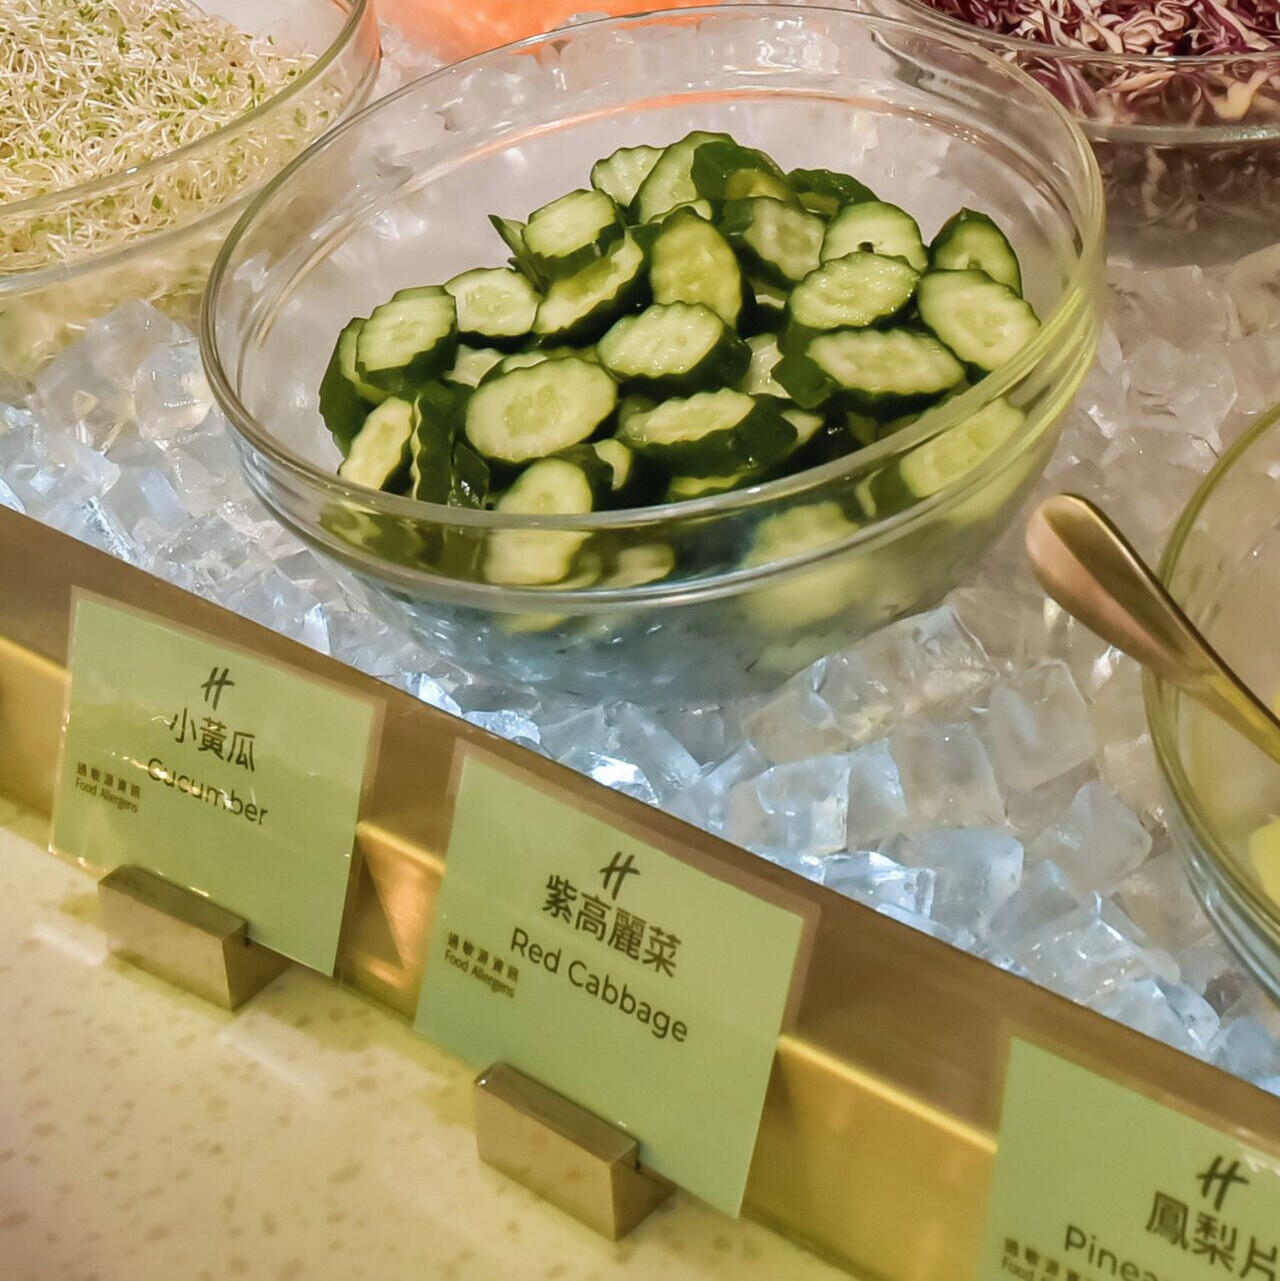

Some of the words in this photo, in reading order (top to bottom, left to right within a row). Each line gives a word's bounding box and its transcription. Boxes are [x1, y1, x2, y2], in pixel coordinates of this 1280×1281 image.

[169, 707, 256, 774] 小黃瓜
[75, 777, 98, 797] Food
[147, 757, 269, 826] Cucumber
[444, 947, 469, 973] Food
[541, 874, 682, 979] 紫高麗菜
[510, 926, 563, 975] Red
[567, 959, 689, 1043] Cabbage
[1145, 1190, 1278, 1281] 鳳梨片
